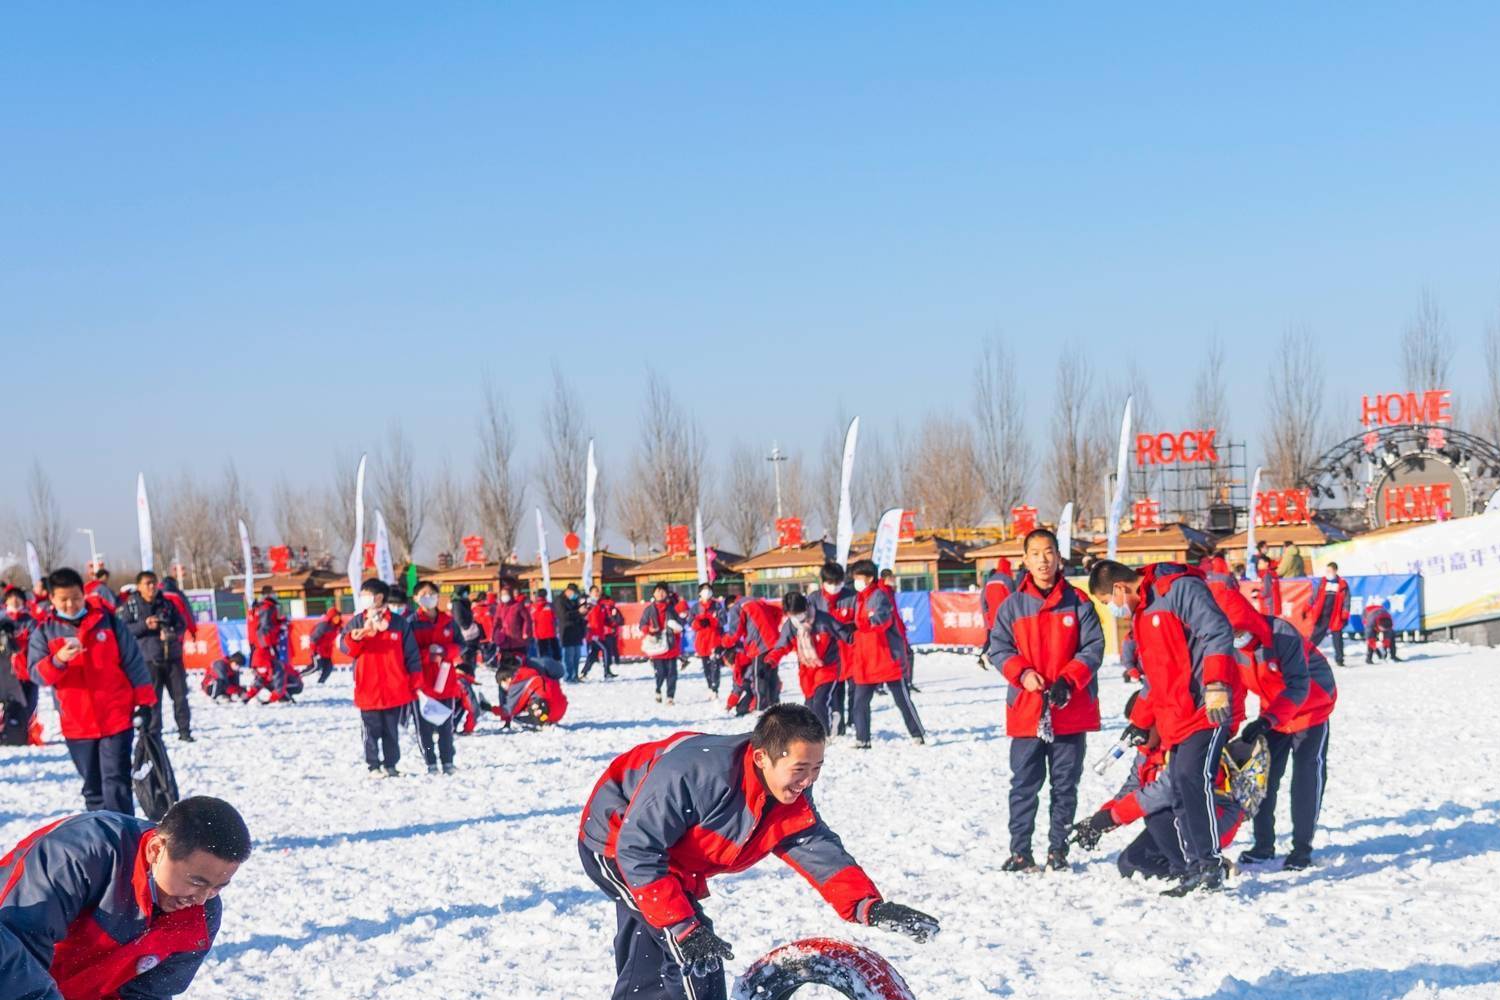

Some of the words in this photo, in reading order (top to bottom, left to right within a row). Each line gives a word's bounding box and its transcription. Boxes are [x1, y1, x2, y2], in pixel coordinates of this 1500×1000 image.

[1362, 389, 1452, 427] HOME
[1136, 429, 1219, 465] ROCK
[1384, 484, 1452, 522] HOME
